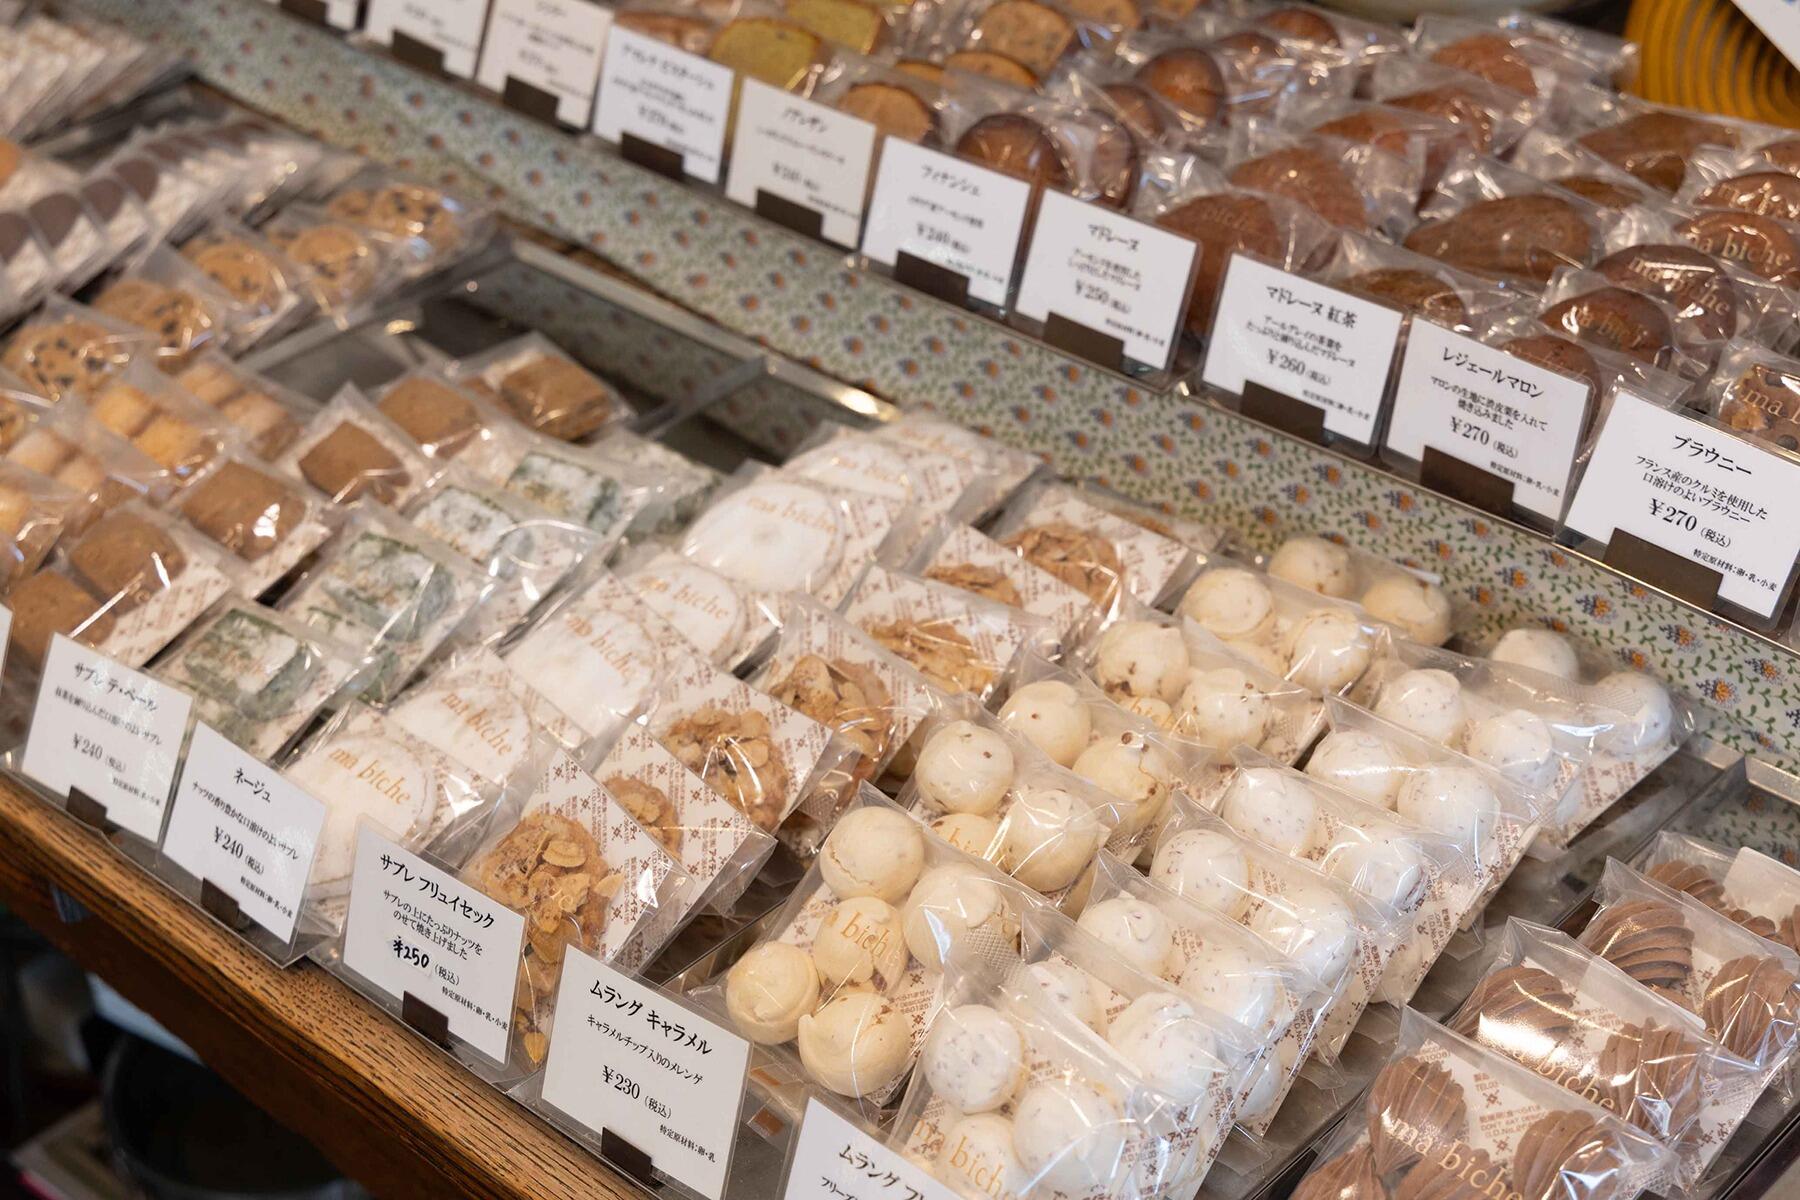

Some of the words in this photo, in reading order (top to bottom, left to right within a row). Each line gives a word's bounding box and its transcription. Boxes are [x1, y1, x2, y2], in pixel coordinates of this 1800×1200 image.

[1266, 286, 1323, 316] マドレーヌ
[1328, 306, 1358, 329] 紅茶
[1267, 349, 1306, 375] ¥260
[1443, 347, 1545, 399] レジェールマロン
[1458, 399, 1514, 430] 焼き込みました
[1742, 389, 1784, 416] ma
[1450, 416, 1490, 446] ¥270
[1492, 440, 1519, 459] （税込）
[1672, 435, 1752, 475] ブラウニー
[1635, 456, 1768, 520] フランス産のクルミを使用した
[1642, 473, 1751, 523] 口溶けのよいブラウニー
[1649, 498, 1697, 531] ¥270
[1700, 527, 1731, 548] （税込）
[1692, 548, 1777, 592] 特定原材料：卵・乳・小麦
[75, 662, 104, 686] サブレ
[72, 732, 103, 759] ¥240
[465, 708, 513, 756] biche
[233, 767, 271, 803] ネージュ
[329, 748, 360, 771] ma
[356, 759, 412, 805] biche
[214, 826, 244, 859] ¥240
[244, 854, 265, 875] （税込）
[380, 853, 415, 882] サブレ
[418, 875, 495, 929] フリュイセック
[383, 889, 483, 957] サブレの上にたっぷりナッツを
[393, 910, 468, 961] のせて焼き上げました
[393, 935, 430, 968] ¥250
[434, 963, 460, 986] （税込）
[442, 985, 508, 1031] 特定原材料：卵・乳・小麦
[589, 979, 643, 1017] ムラング
[646, 1009, 713, 1056] キャラメル
[586, 1013, 703, 1085] キャラメルチップ入りのメレンゲ
[602, 1064, 641, 1100] ¥230
[643, 1095, 672, 1120] （税込）
[659, 1123, 716, 1163] 特定原材料：卵・乳
[1391, 1118, 1434, 1157] ma
[839, 1144, 901, 1188] ムラング
